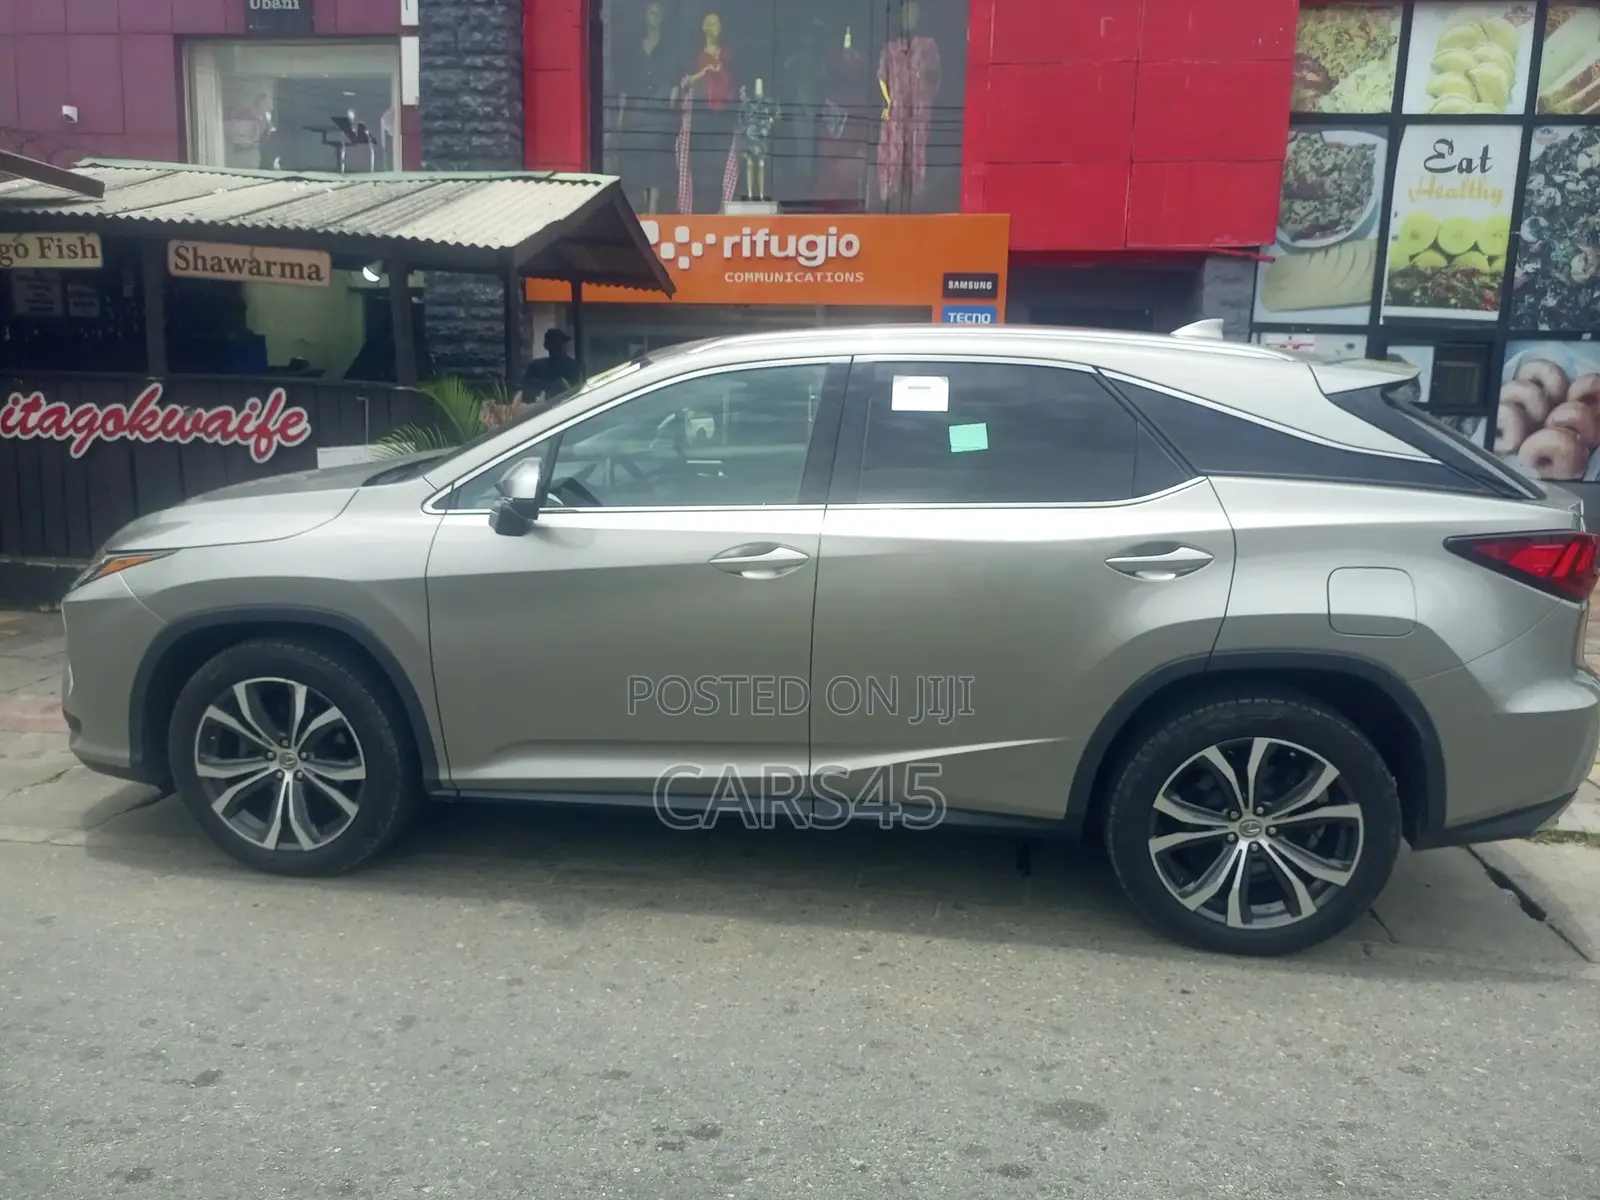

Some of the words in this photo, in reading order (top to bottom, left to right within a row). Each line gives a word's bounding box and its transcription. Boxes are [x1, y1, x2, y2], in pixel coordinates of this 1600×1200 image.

[1423, 138, 1494, 174] Eat
[1408, 175, 1503, 207] Healthy
[35, 236, 99, 259] Fish
[723, 226, 861, 267] rifugio
[174, 245, 324, 282] Shawarma
[724, 271, 864, 283] COMMUNICATIONS
[948, 280, 992, 290] SAMSUNG
[948, 312, 991, 324] TECNO
